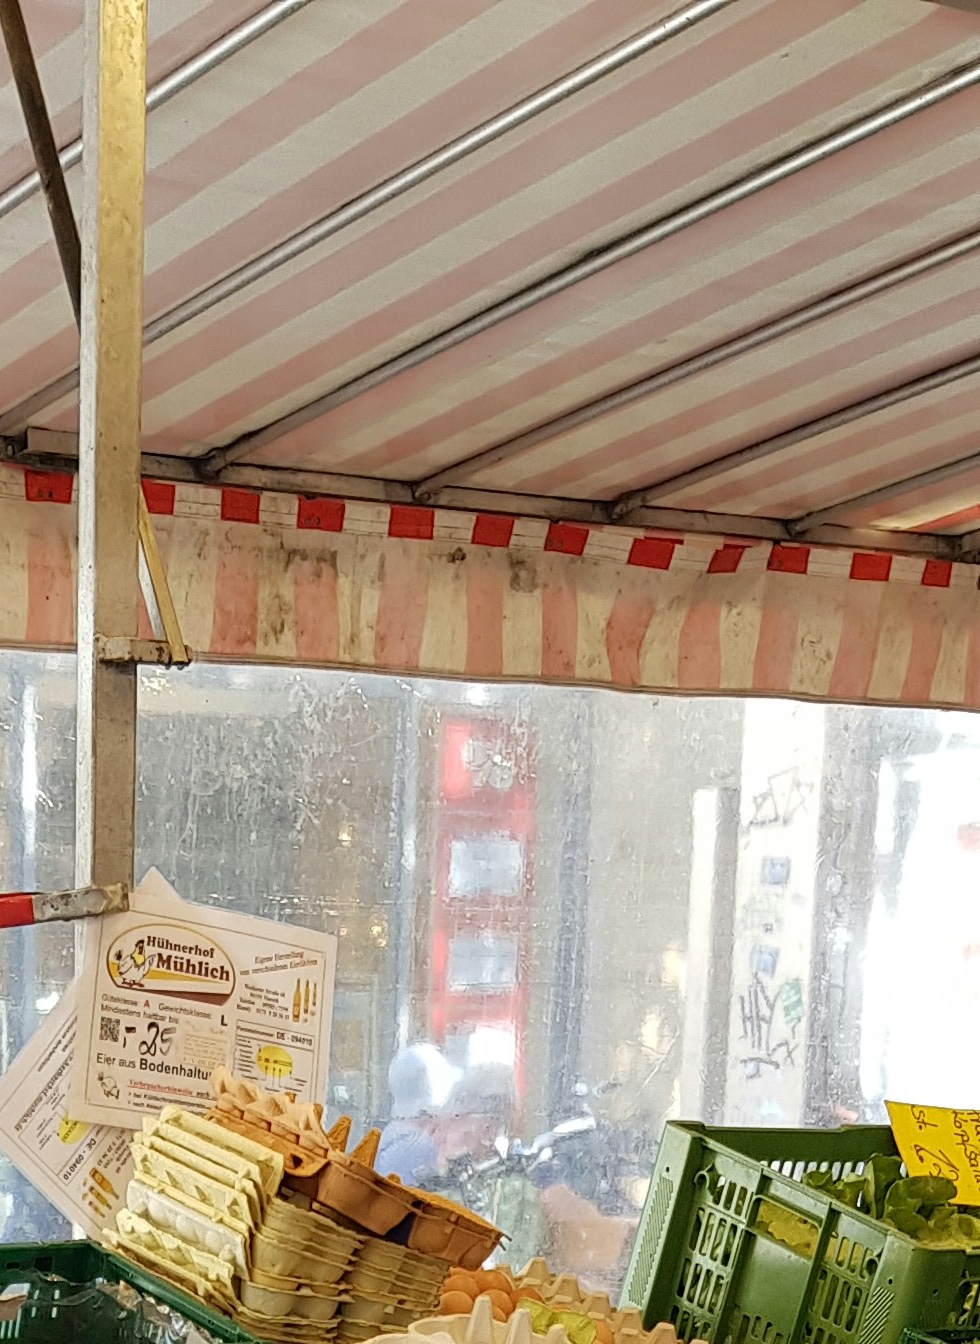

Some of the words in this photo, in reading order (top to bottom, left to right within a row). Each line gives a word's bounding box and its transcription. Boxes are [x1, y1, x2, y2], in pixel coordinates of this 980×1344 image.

[146, 935, 215, 959] Hühnerhof
[156, 952, 230, 982] Mühlich
[143, 999, 151, 1009] A
[220, 1014, 228, 1027] L
[96, 1052, 116, 1068] Eier
[118, 1058, 137, 1069] aus
[139, 1057, 212, 1081] Bodenhaltu
